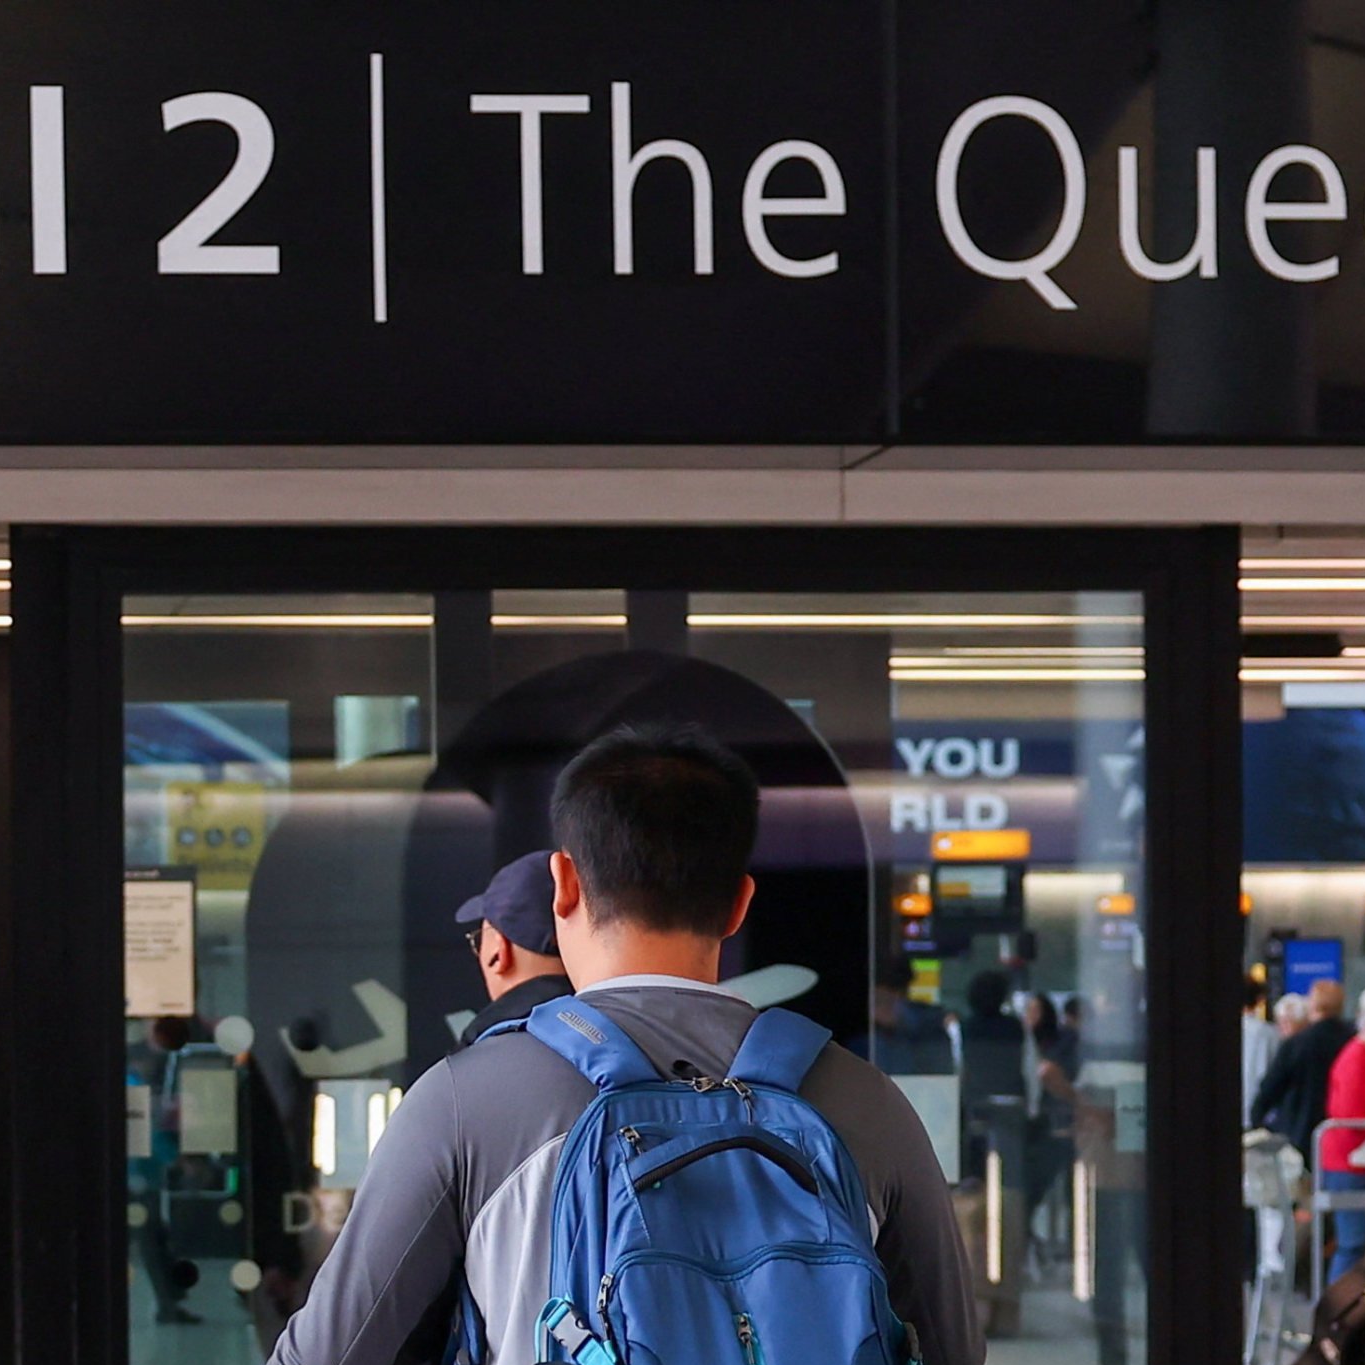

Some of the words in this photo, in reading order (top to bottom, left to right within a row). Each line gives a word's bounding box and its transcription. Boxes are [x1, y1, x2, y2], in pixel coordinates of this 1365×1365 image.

[157, 92, 280, 275] 2
[470, 81, 847, 278] The
[895, 737, 1020, 778] YOU
